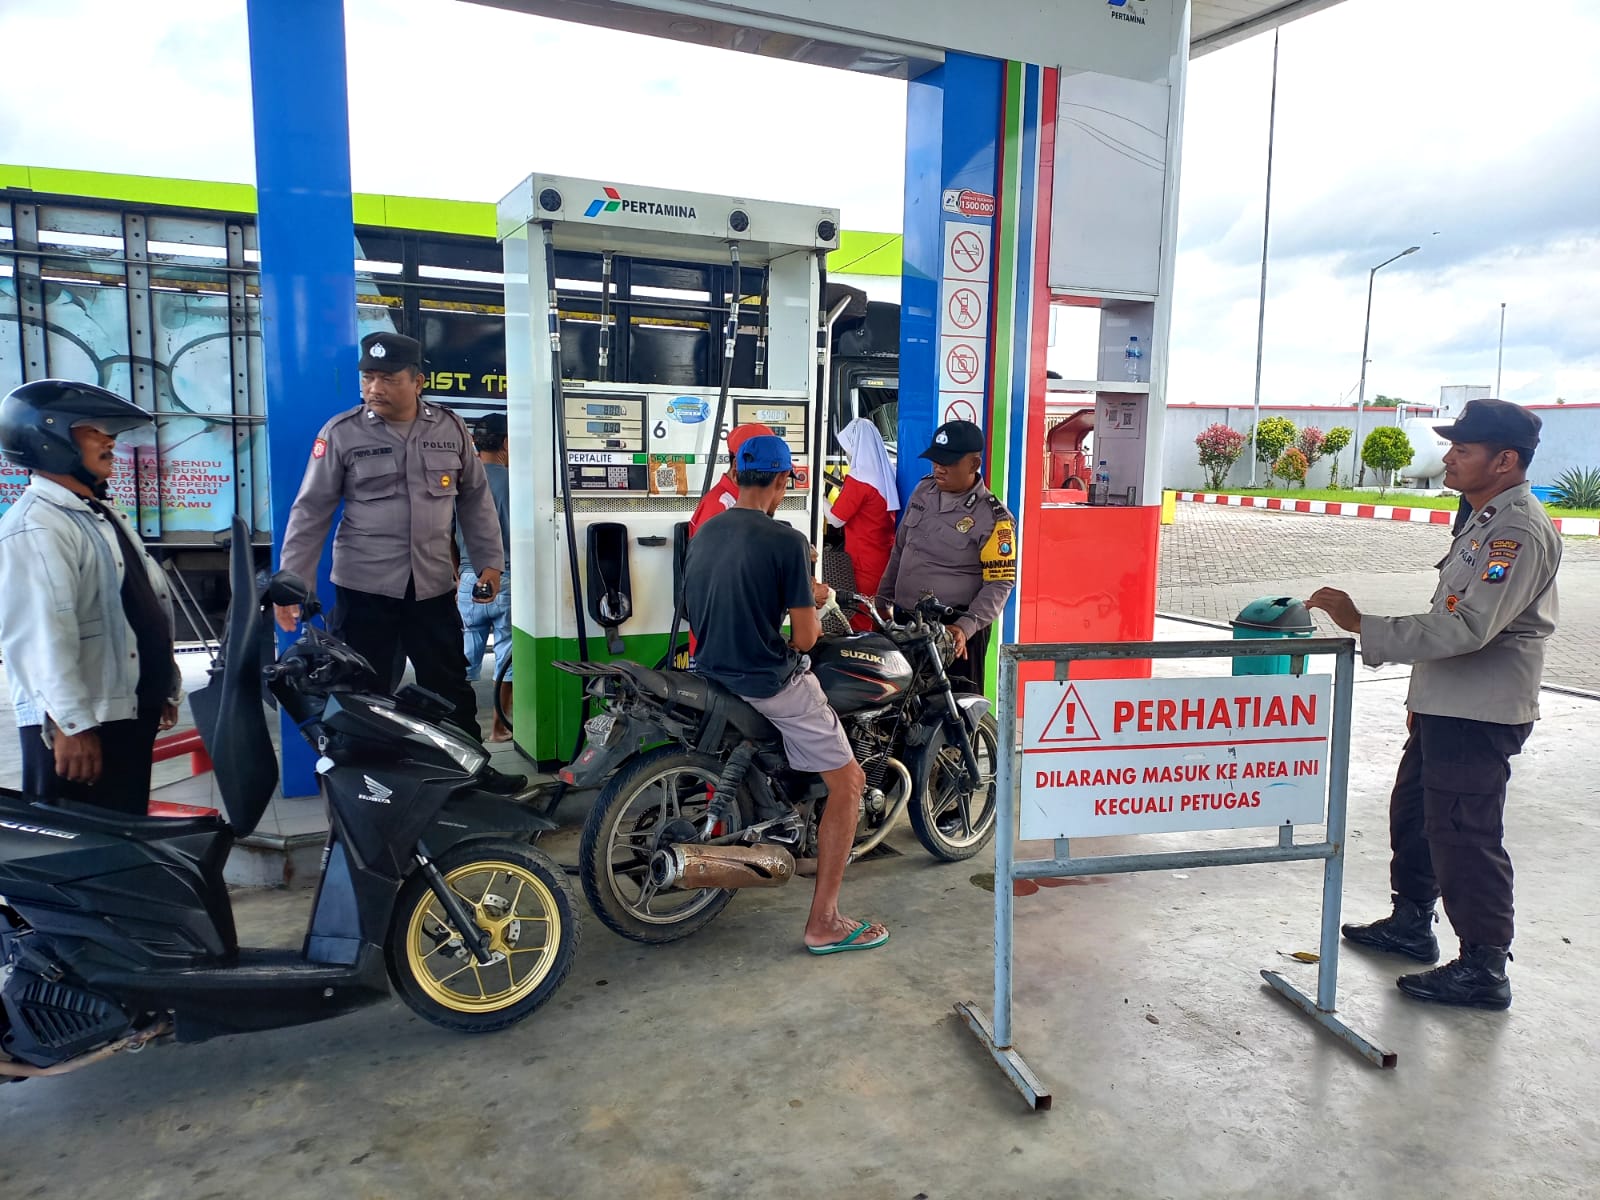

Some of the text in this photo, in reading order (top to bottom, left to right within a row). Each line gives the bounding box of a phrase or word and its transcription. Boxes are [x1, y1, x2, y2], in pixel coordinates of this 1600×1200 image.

[1111, 11, 1145, 25] PERTAMINA
[622, 200, 697, 219] PERTAMINA
[653, 420, 667, 439] 6
[422, 441, 457, 449] POLISI
[171, 460, 222, 468] SENDU
[569, 454, 612, 463] PERTALITE
[840, 649, 886, 666] SUZUKI
[1113, 694, 1317, 733] PERHATIAN
[1035, 760, 1319, 788] DILARANG MASUK KE AREA INI
[1094, 791, 1261, 816] KECUALI PETUGAS
